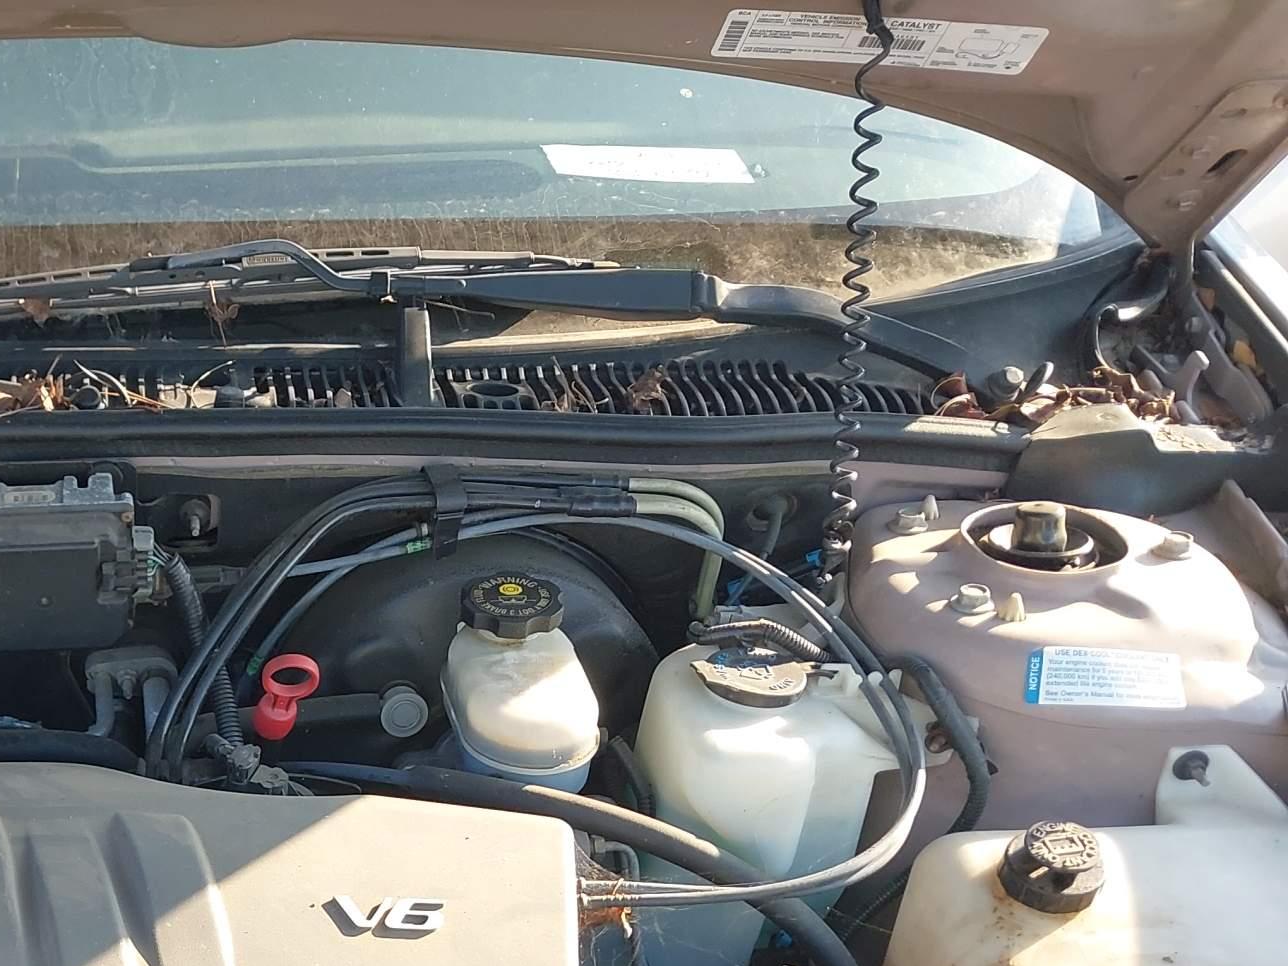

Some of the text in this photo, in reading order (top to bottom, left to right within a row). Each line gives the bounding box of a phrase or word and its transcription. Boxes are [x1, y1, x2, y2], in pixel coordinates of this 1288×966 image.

[890, 20, 942, 30] CATALYST
[478, 576, 538, 590] WARNING
[1028, 656, 1040, 690] NOTICE
[1032, 822, 1081, 837] ENGINE
[1062, 831, 1097, 868] COOLANT
[321, 895, 445, 940] V6
